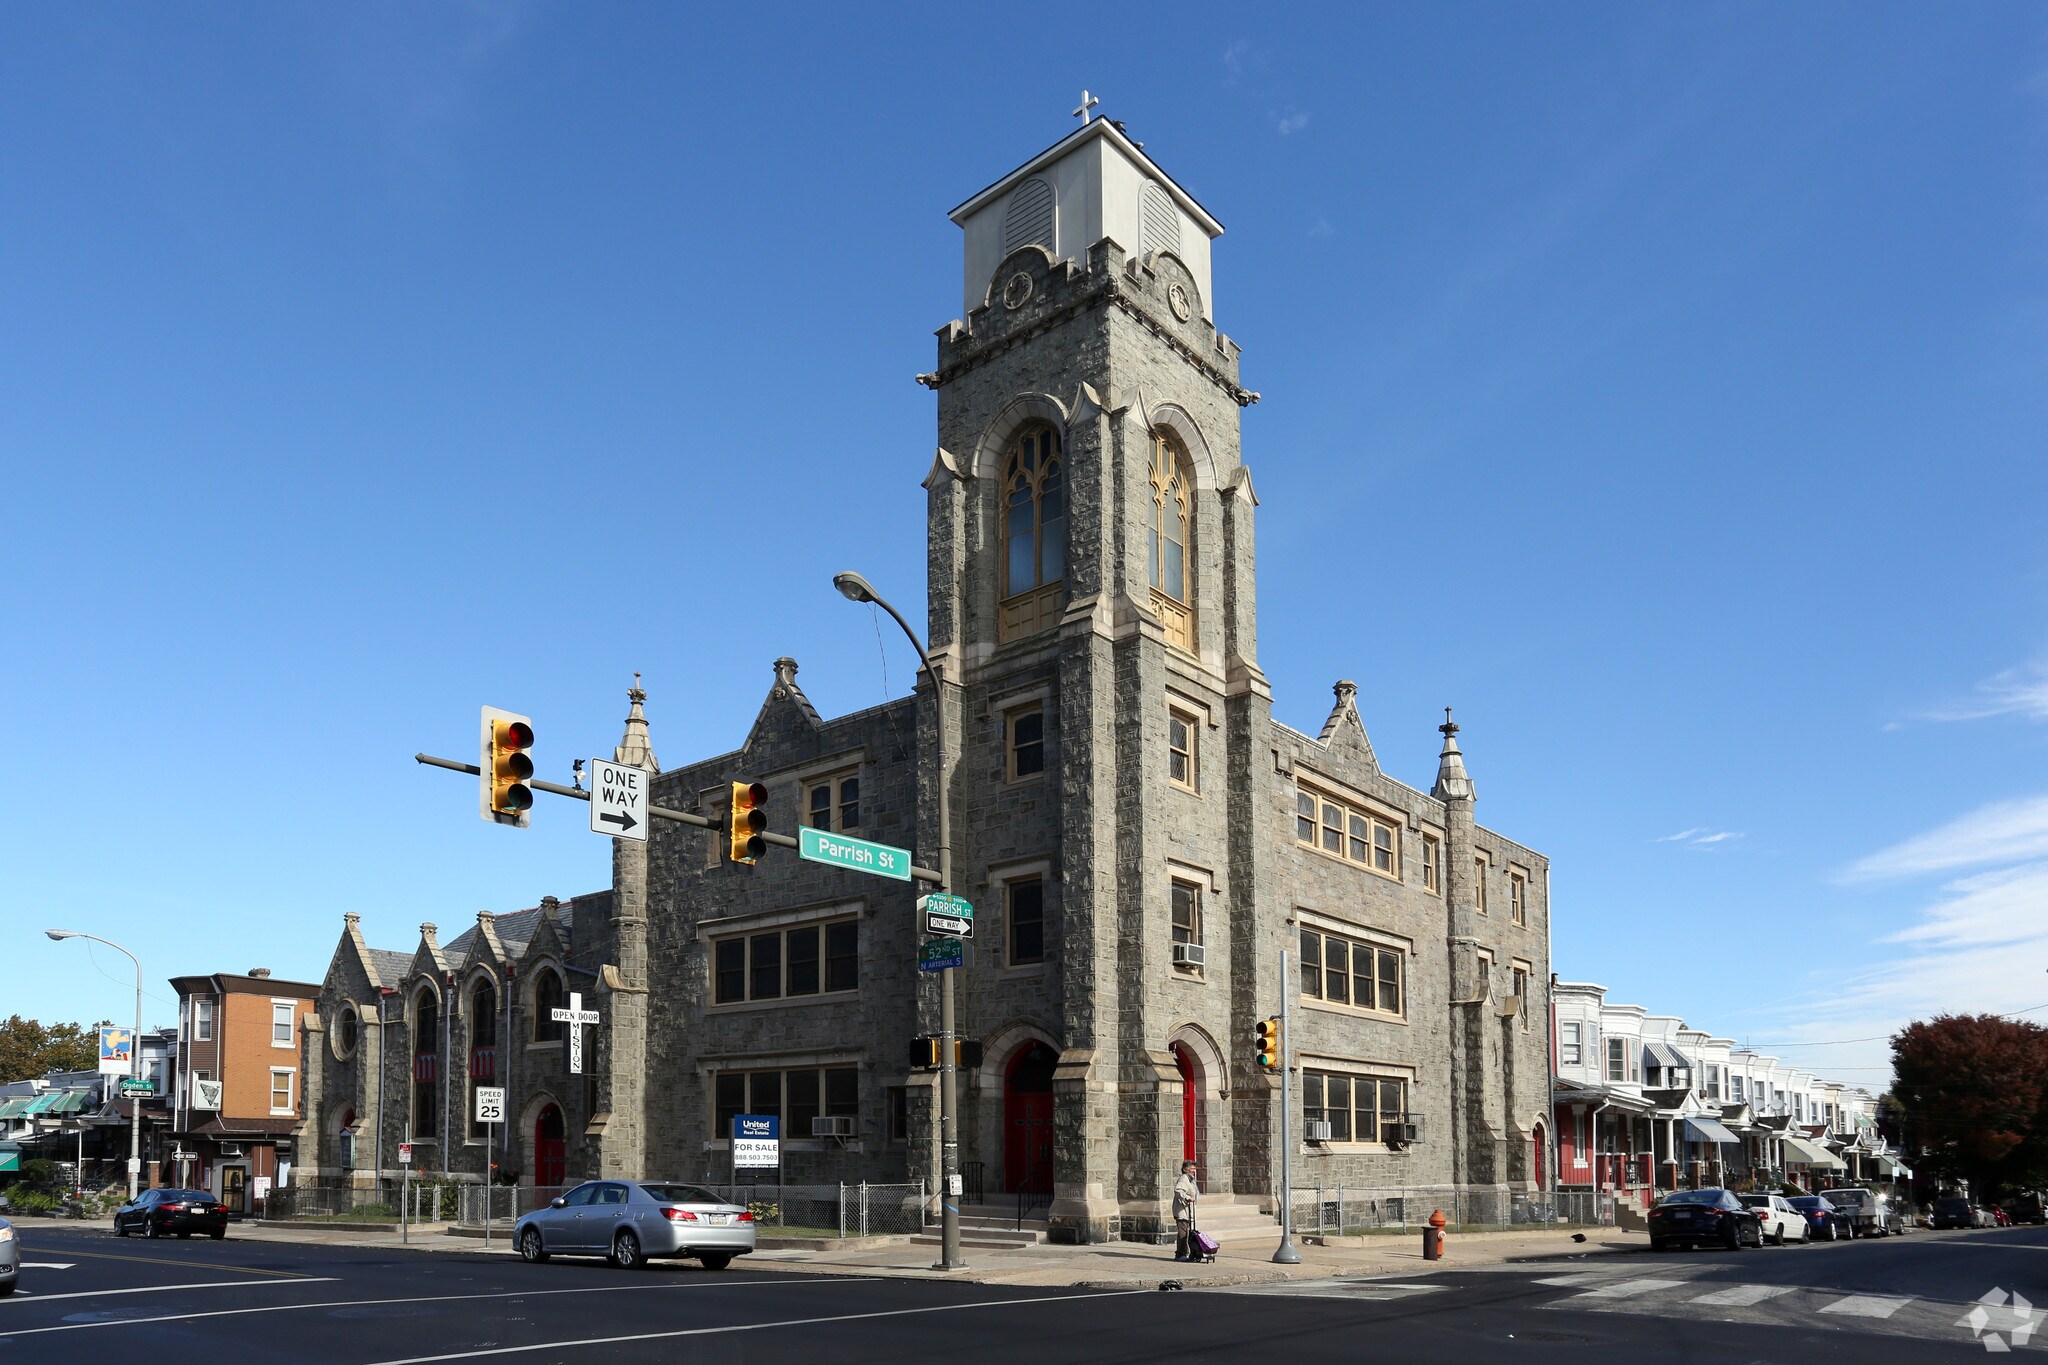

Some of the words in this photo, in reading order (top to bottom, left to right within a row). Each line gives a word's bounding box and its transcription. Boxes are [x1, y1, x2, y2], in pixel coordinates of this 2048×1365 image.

[603, 768, 637, 789] ONE
[602, 787, 638, 808] WAY
[818, 837, 873, 865] Parrish
[878, 851, 894, 869] St
[928, 900, 962, 916] PARRISH
[964, 909, 971, 917] ST
[932, 918, 945, 927] ONE
[946, 921, 960, 930] WAY
[952, 947, 960, 956] ST
[920, 962, 927, 970] N
[928, 959, 953, 968] ARTERIAL
[955, 957, 961, 966] S
[553, 1010, 575, 1020] OPEN
[578, 1012, 599, 1022] DOOR
[572, 1022, 580, 1069] MISSION
[481, 1105, 500, 1118] 25
[742, 1120, 770, 1128] United
[734, 1143, 753, 1151] FOR
[755, 1144, 778, 1152] SALE
